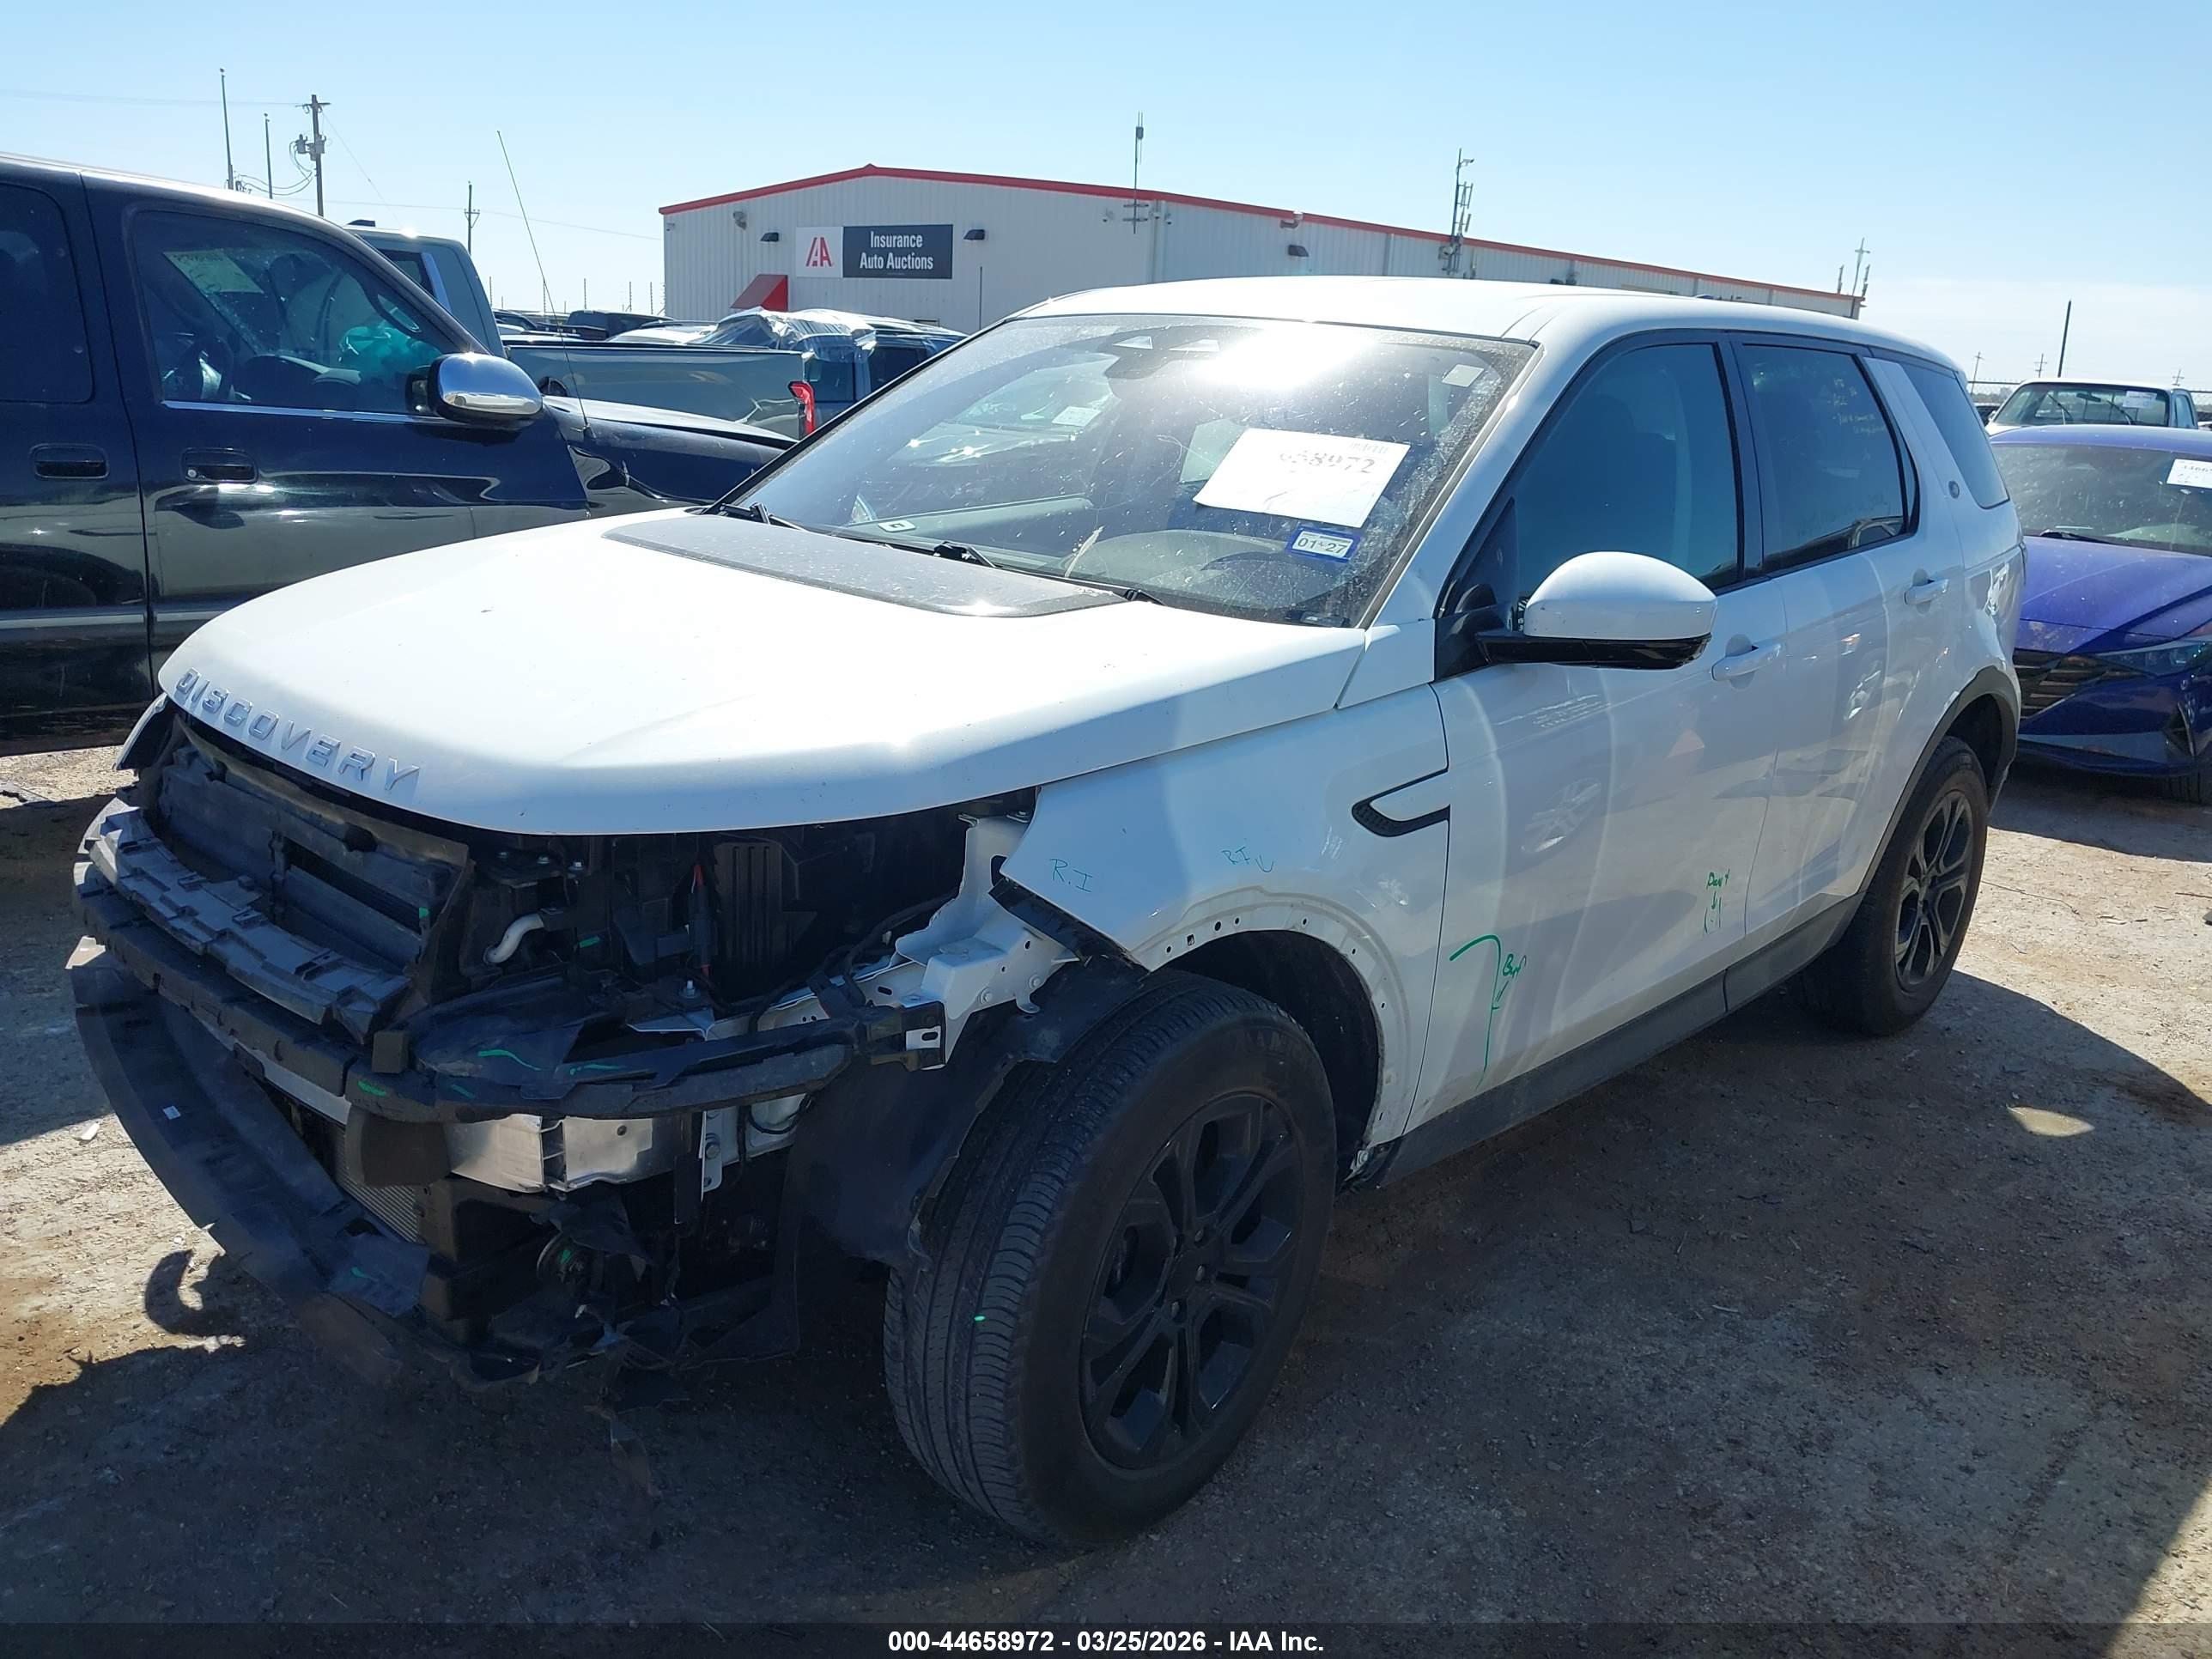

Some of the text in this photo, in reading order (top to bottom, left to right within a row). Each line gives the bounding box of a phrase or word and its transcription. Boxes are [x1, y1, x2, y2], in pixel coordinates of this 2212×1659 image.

[870, 230, 923, 248] Insurance
[860, 252, 934, 270] Auto Auctions
[176, 666, 420, 791] DISCOVERY
